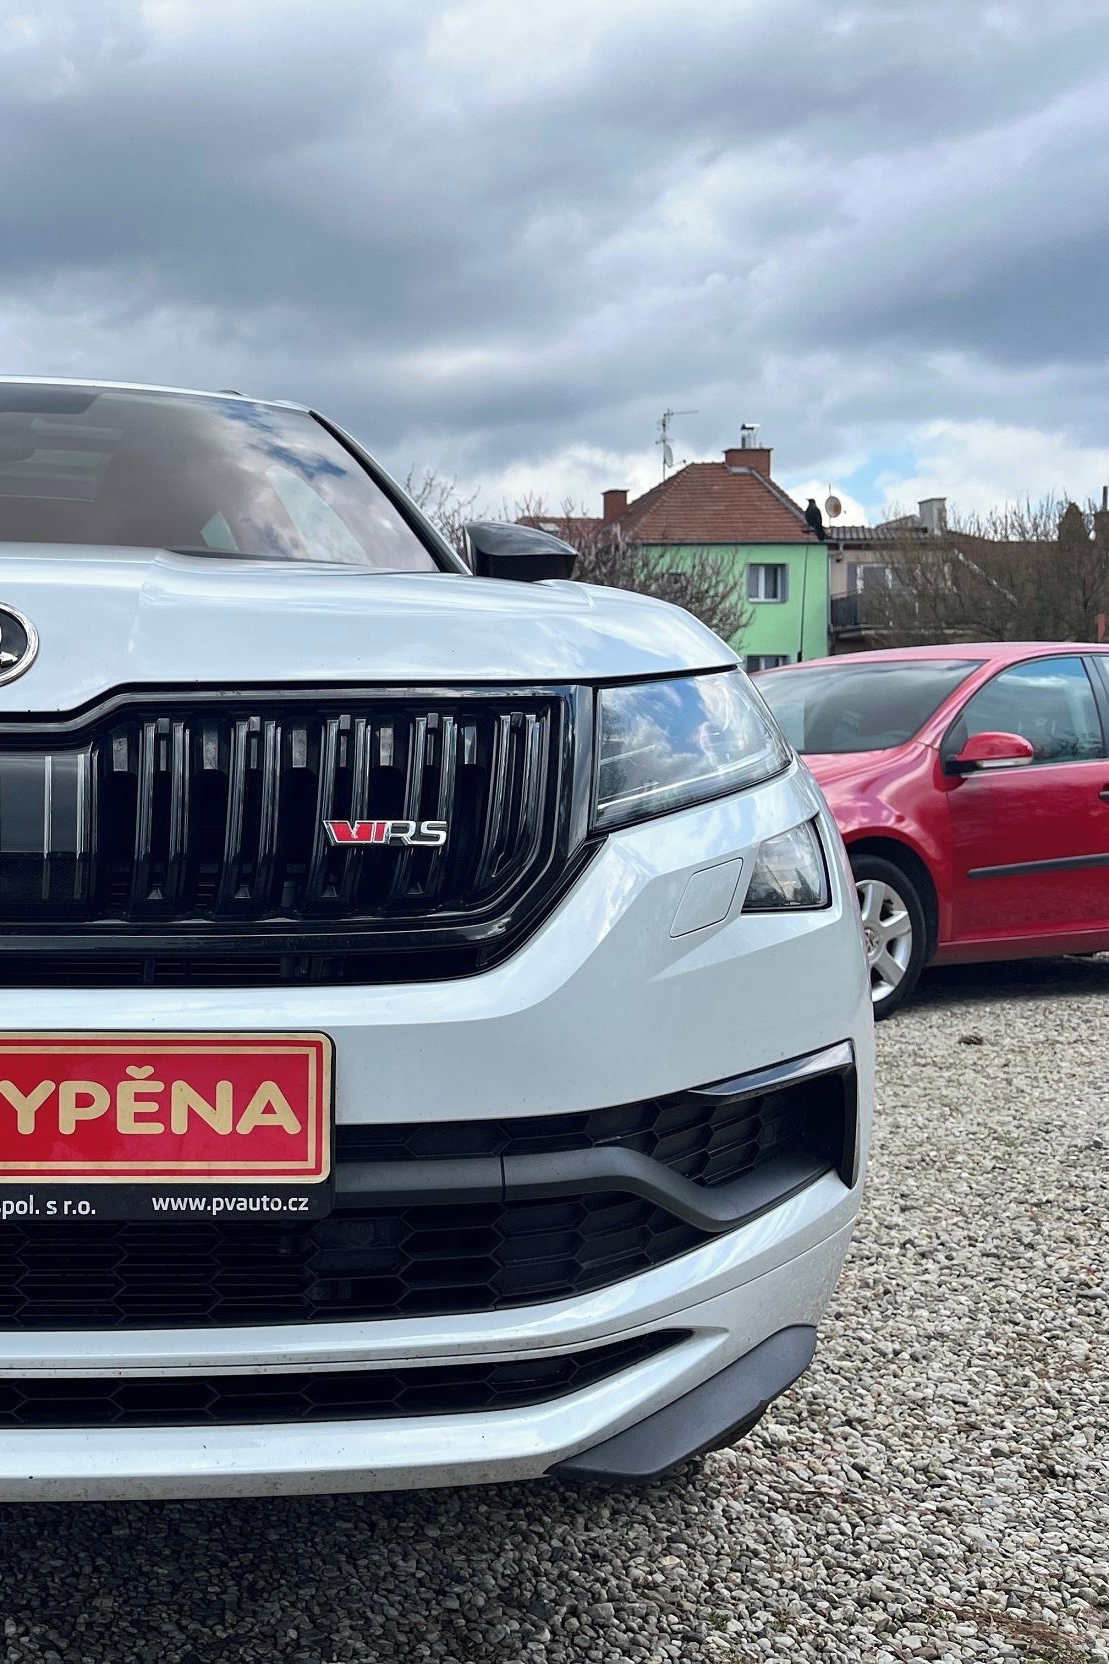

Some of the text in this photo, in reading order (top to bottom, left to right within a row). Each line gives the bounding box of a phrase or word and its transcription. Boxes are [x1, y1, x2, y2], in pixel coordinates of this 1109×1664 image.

[46, 1200, 58, 1215] s
[63, 1200, 96, 1215] r.o.
[151, 1195, 309, 1216] www.pvauto.cz
